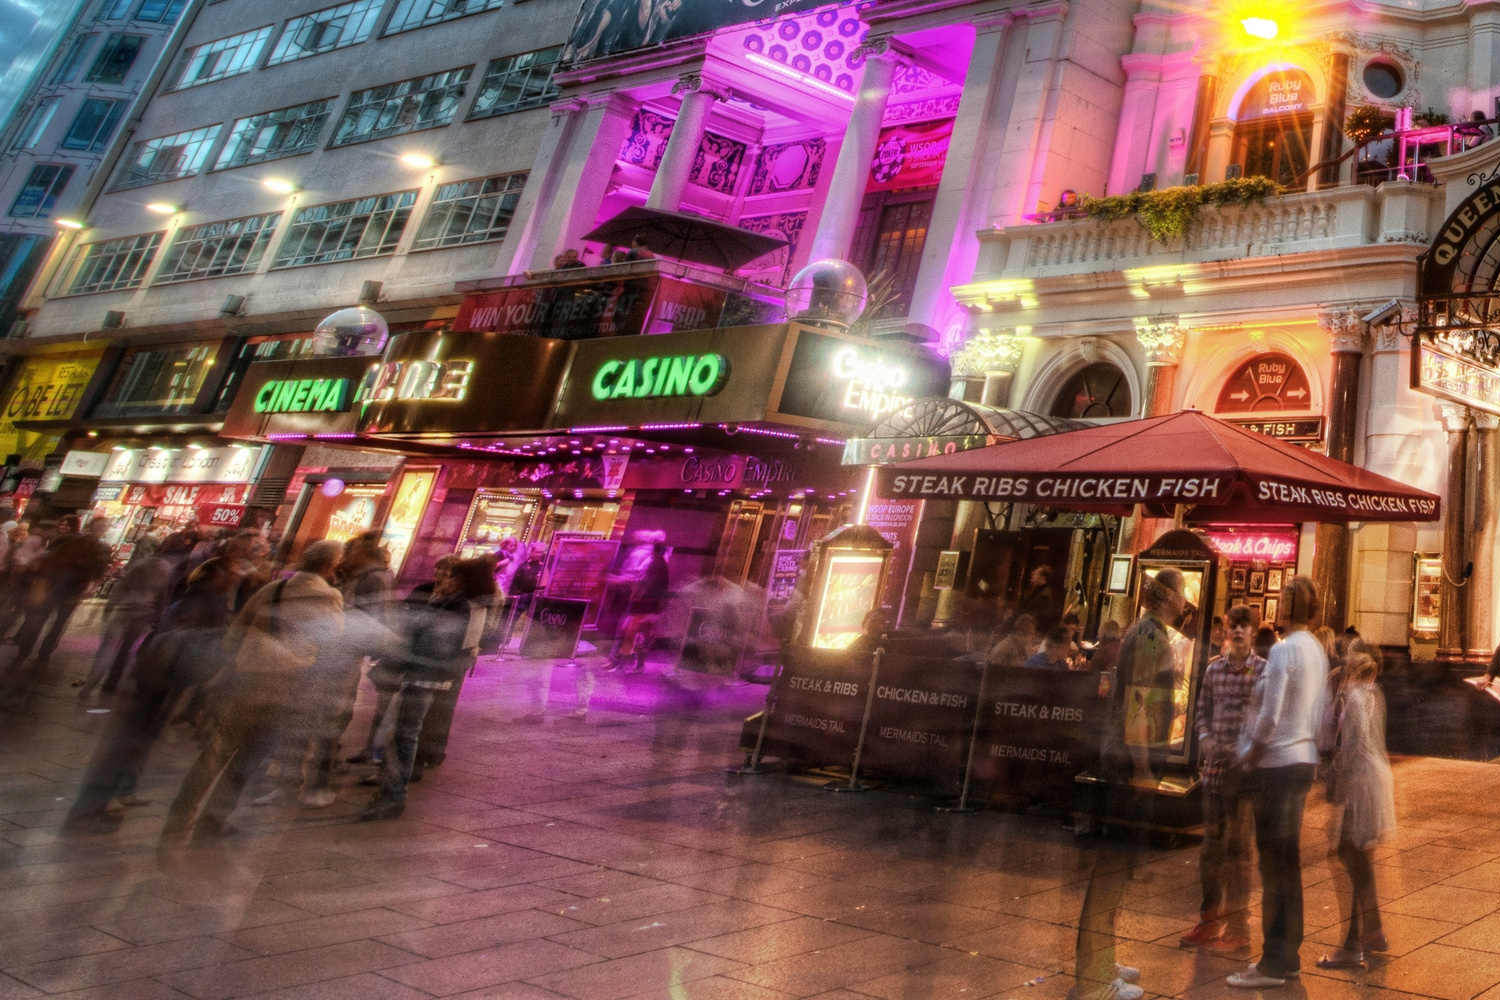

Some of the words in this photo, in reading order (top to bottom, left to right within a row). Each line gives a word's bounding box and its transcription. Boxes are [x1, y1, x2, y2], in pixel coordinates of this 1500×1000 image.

[1269, 80, 1302, 93] Ruby
[1270, 92, 1298, 105] Blue
[1263, 103, 1303, 115] BALCONY
[910, 141, 937, 152] WSOP
[469, 306, 502, 329] WIN
[502, 300, 550, 326] YOUR
[660, 300, 707, 328] WSOP
[592, 353, 721, 400] CASINO
[1258, 362, 1286, 377] Ruby
[1259, 373, 1283, 385] Blue
[22, 384, 55, 417] BE
[45, 383, 84, 416] LET
[253, 378, 345, 413] CINEMA
[1263, 423, 1296, 436] FISH
[870, 441, 957, 460] CASINO
[182, 455, 221, 470] London
[163, 486, 200, 505] SALE
[892, 475, 969, 496] STEAK
[971, 477, 1030, 497] RIBS
[1036, 478, 1151, 499] CHICKEN
[1156, 478, 1220, 498] FISH
[1258, 480, 1313, 504] STEAK
[1313, 488, 1347, 509] RIBS
[1348, 493, 1409, 513] CHICKEN
[1409, 497, 1437, 515] FISH
[212, 508, 240, 523] 50%
[868, 504, 888, 514] WSOP
[888, 504, 915, 514] EUROPE
[1150, 549, 1189, 557] MERMAIDS
[1191, 549, 1208, 558] TAIL
[1212, 537, 1242, 555] teak
[1242, 538, 1254, 554] &
[1254, 537, 1293, 558] Chips
[789, 676, 823, 694] STEAK
[823, 681, 832, 693] &
[833, 681, 859, 697] RIBS
[876, 685, 929, 706] CHICKEN
[929, 692, 939, 706] &
[940, 693, 968, 710] FISH
[994, 701, 1038, 720] STEAK
[1039, 705, 1050, 720] &
[1051, 706, 1085, 723] RIBS
[784, 714, 828, 731] MERMAIDS
[828, 719, 846, 734] TAIL
[879, 726, 929, 745] MERMAIDS
[928, 732, 950, 748] TAIL
[991, 744, 1048, 762] MERMAIDS
[1049, 749, 1072, 765] TAIL
